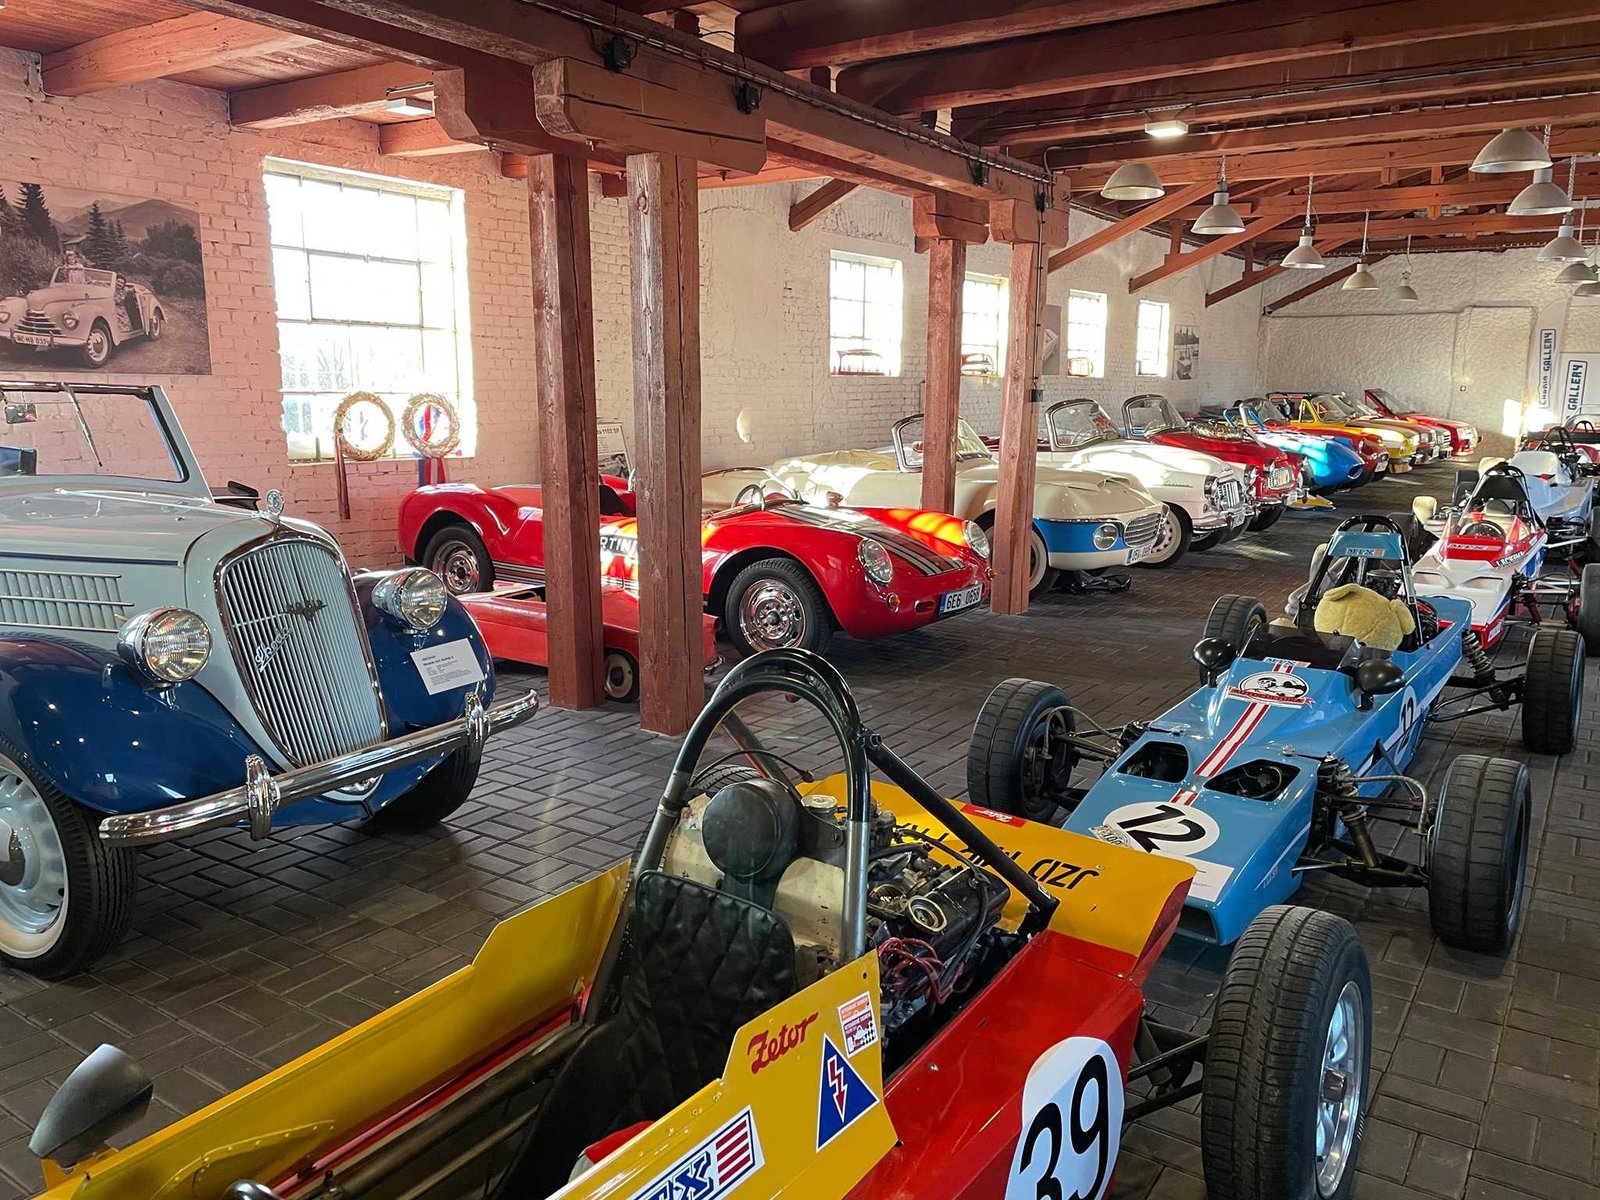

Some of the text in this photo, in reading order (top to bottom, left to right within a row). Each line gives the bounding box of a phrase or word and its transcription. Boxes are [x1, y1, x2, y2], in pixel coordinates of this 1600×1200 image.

[1543, 332, 1553, 371] GALLERY
[1567, 364, 1583, 411] GALLERY
[946, 594, 962, 610] 6E6
[1116, 804, 1207, 854] 12
[1028, 858, 1100, 890] JZD
[747, 1011, 819, 1075] Zetor
[1019, 1054, 1109, 1200] 39
